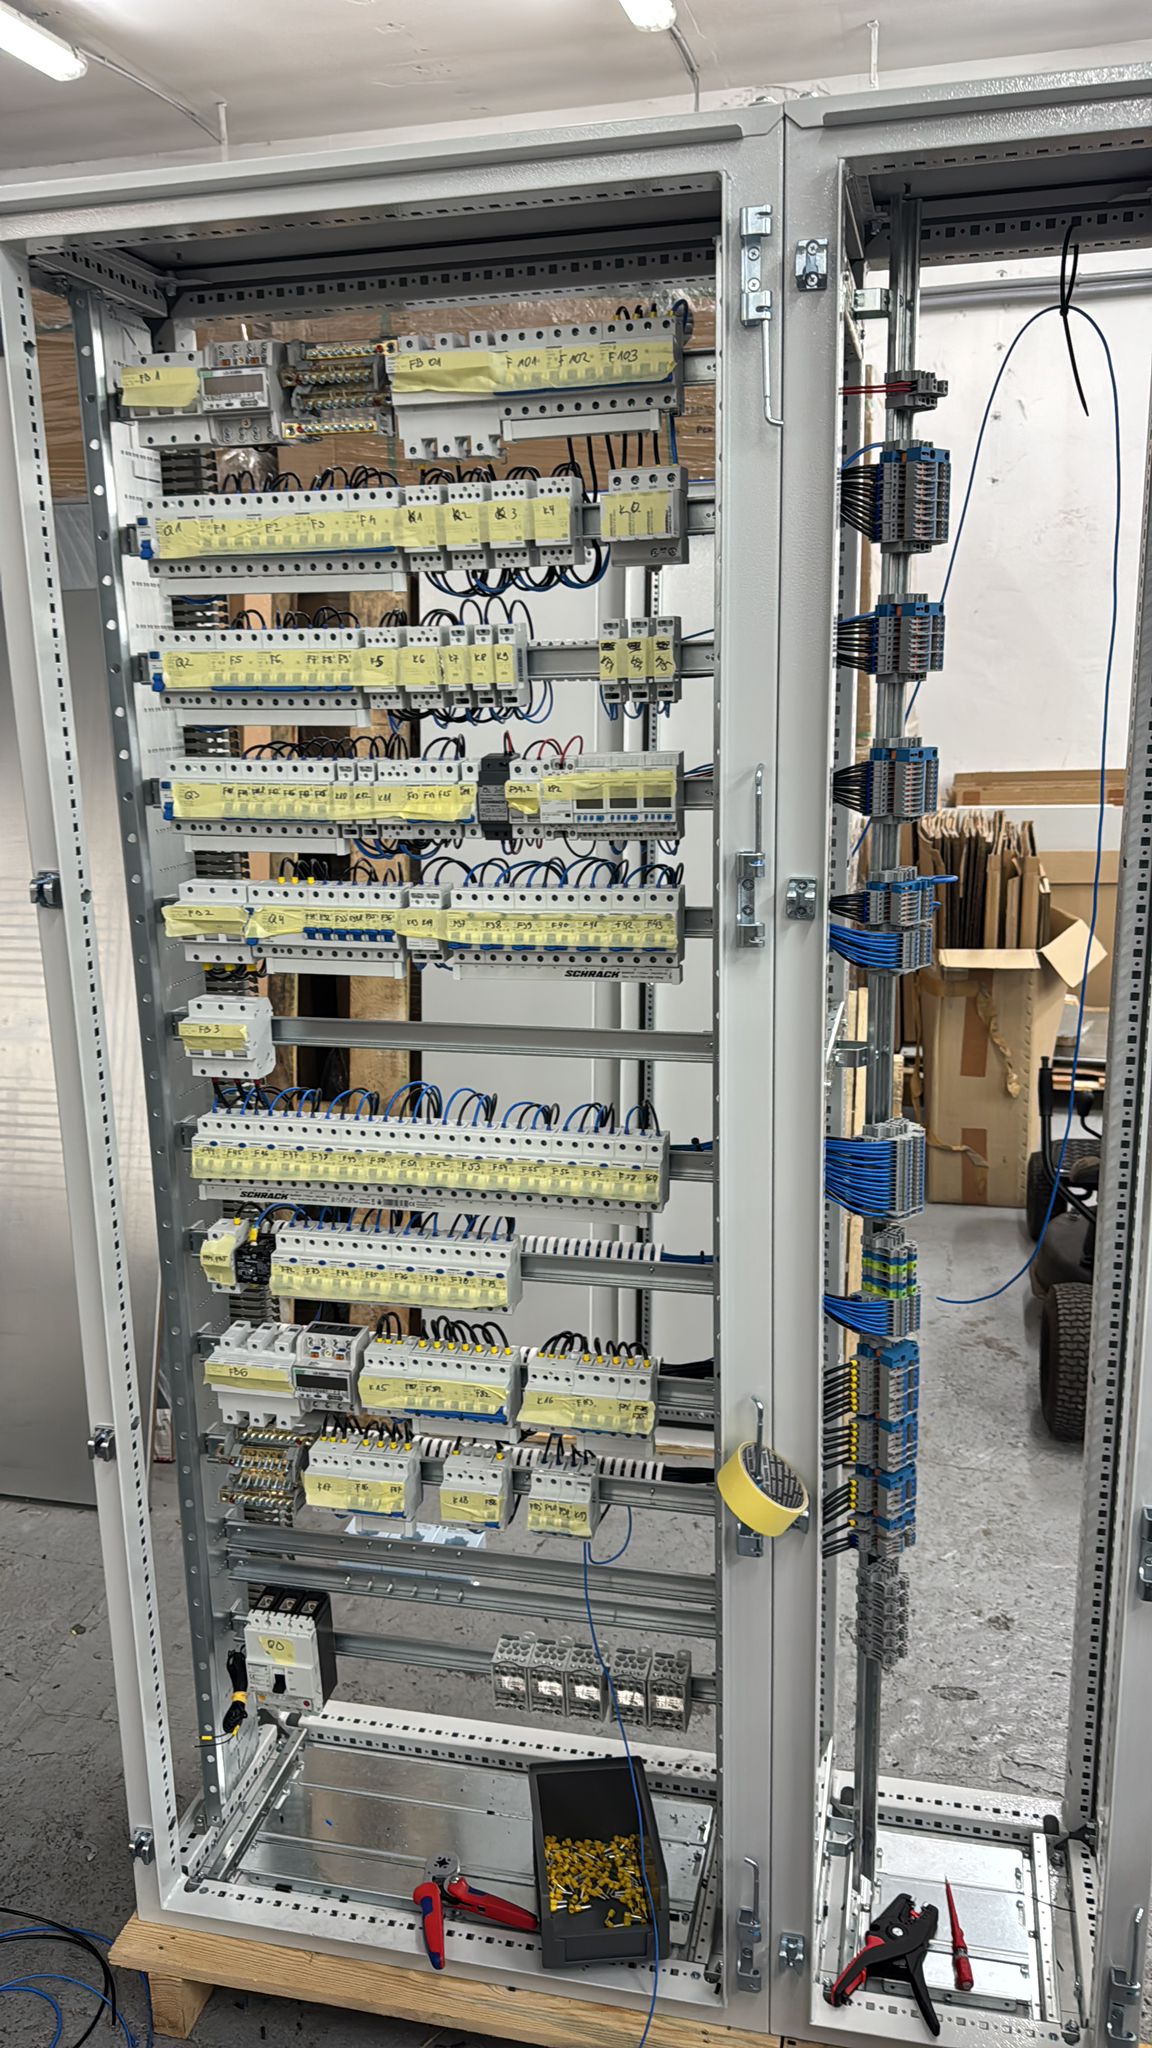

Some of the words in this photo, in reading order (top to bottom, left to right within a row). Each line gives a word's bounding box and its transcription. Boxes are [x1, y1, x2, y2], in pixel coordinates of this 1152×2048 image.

[409, 358, 423, 369] FB
[428, 357, 441, 367] 01
[176, 657, 194, 669] Q2
[229, 655, 243, 665] F5
[564, 970, 620, 978] SCHRACK
[240, 1191, 289, 1199] SCHRACK
